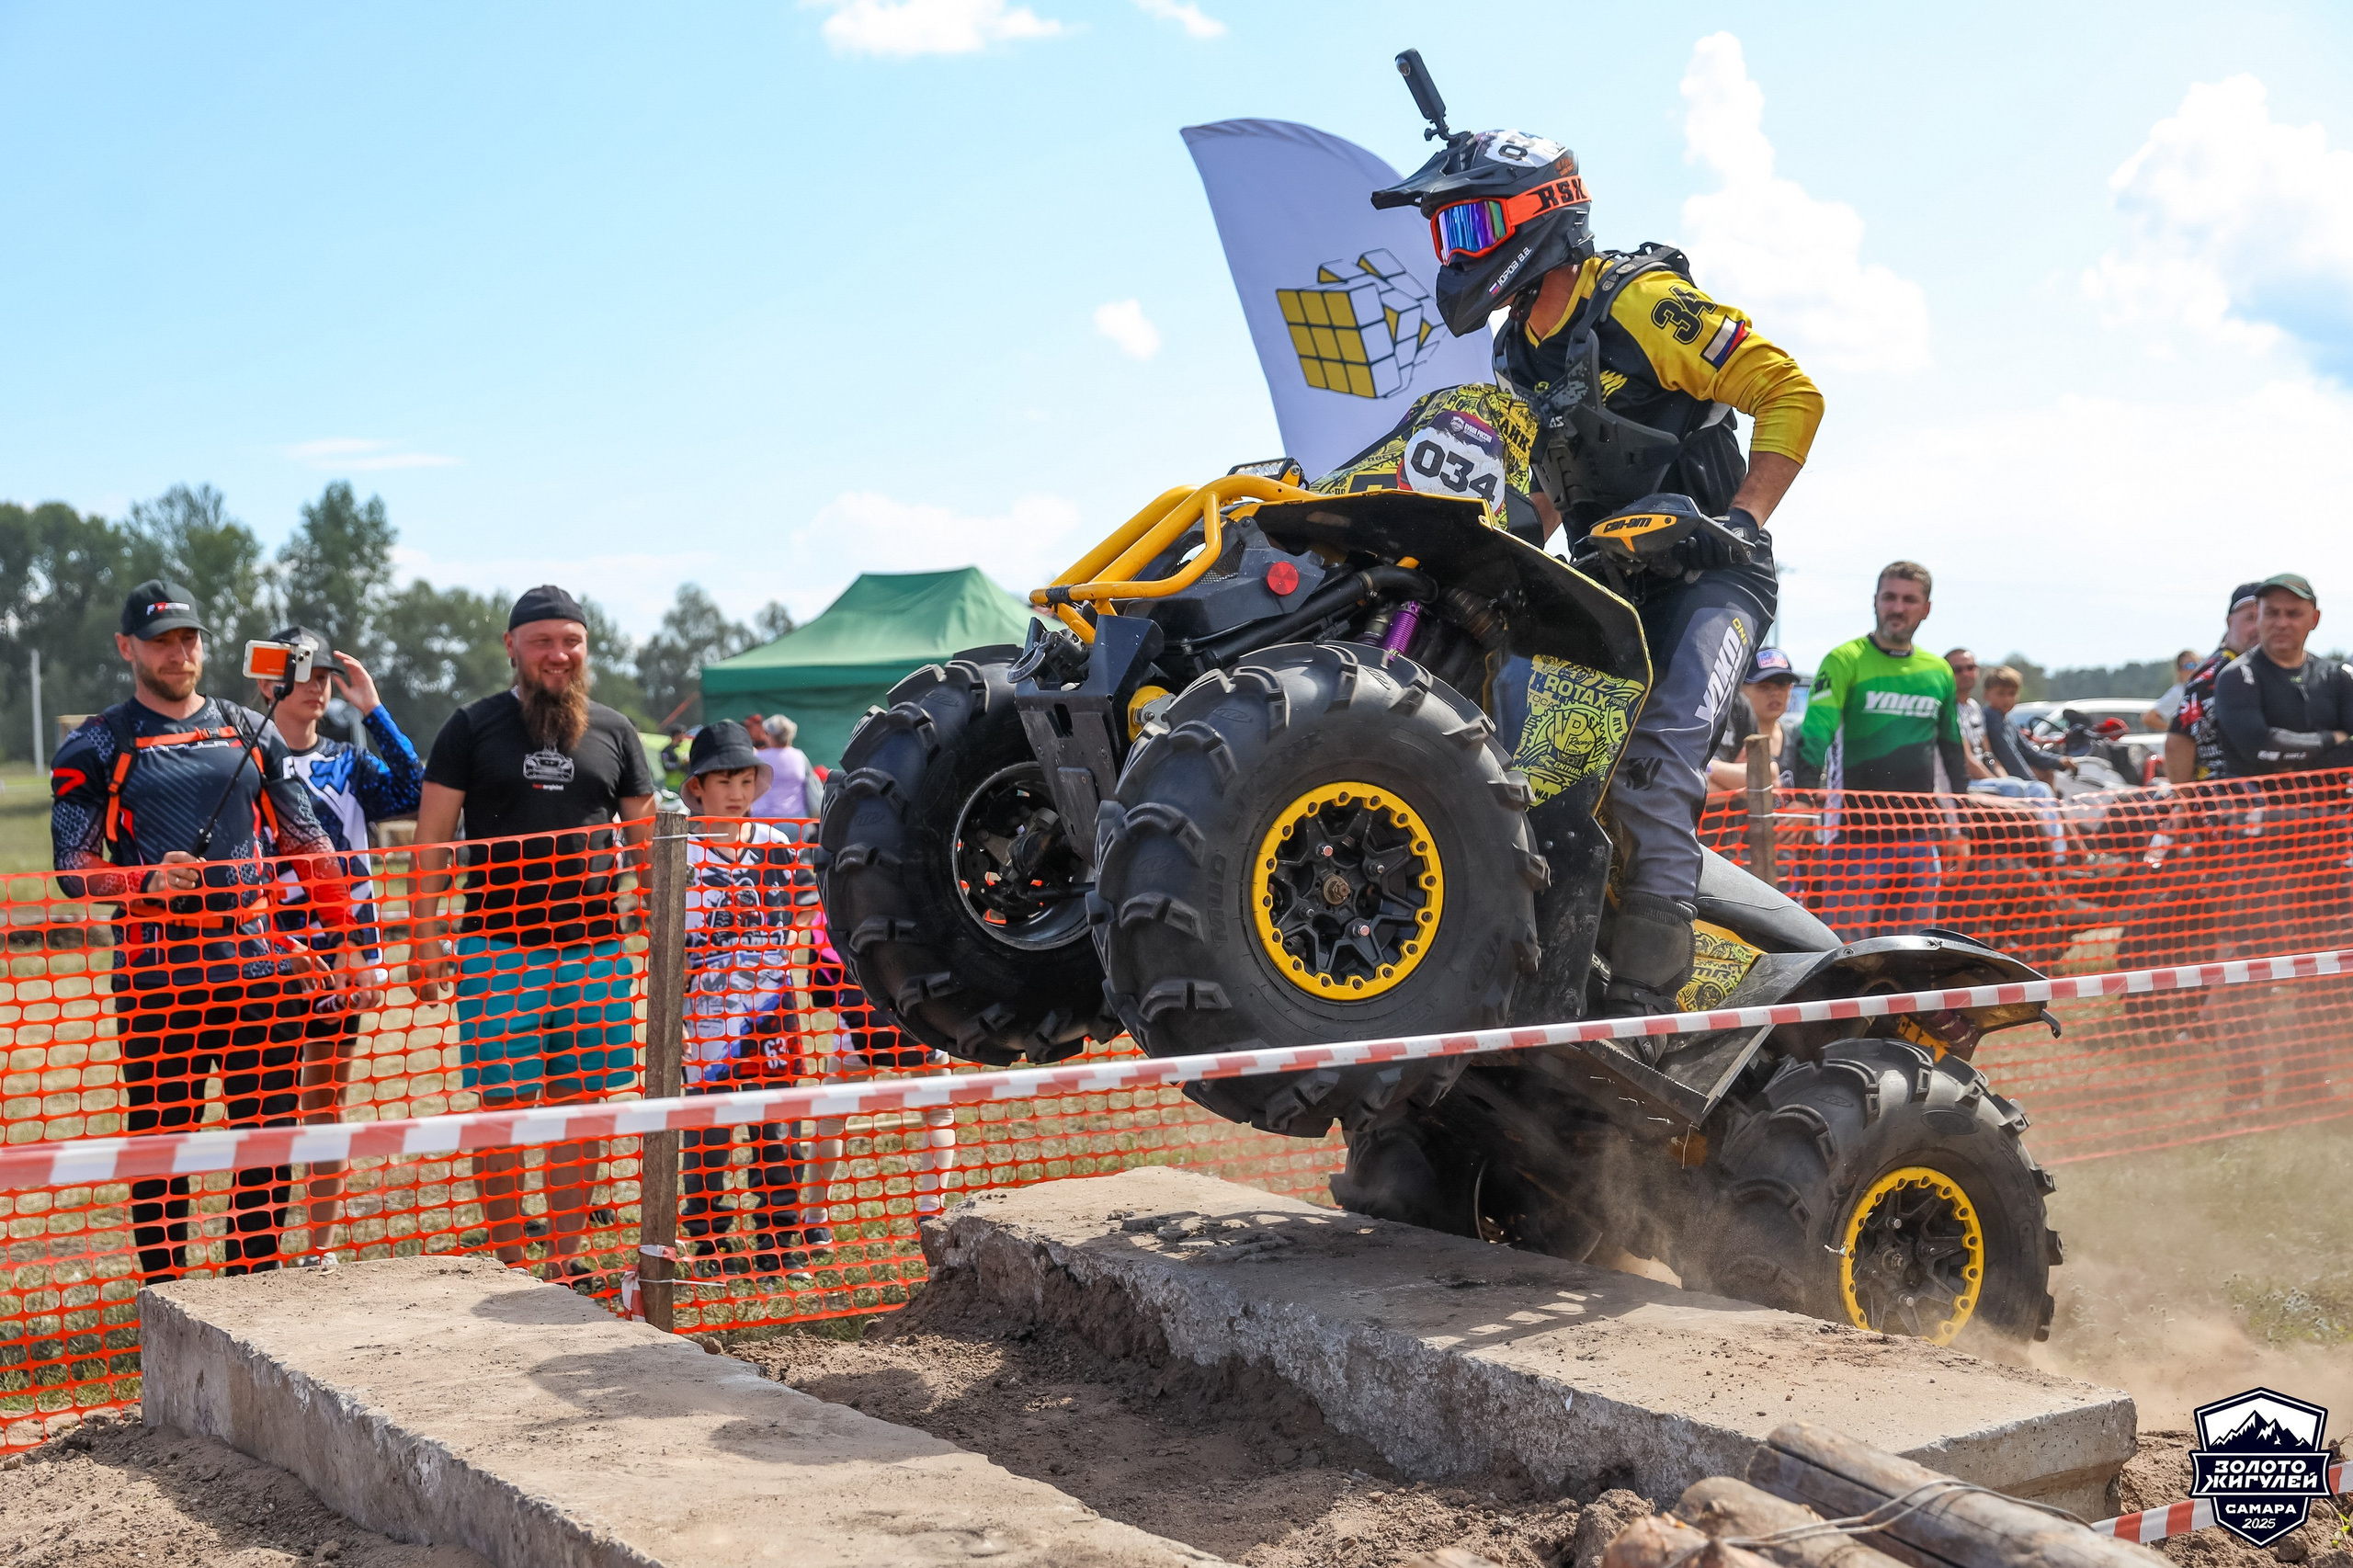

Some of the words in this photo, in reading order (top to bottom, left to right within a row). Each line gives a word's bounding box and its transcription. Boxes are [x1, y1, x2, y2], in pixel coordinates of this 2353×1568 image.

[1497, 260, 1519, 286] ЮРОВ
[1652, 285, 1717, 345] 34
[1498, 418, 1530, 453] АЙК
[1410, 439, 1498, 506] 034
[1603, 517, 1652, 533] can-am
[1695, 626, 1743, 722] YOKO
[1543, 674, 1610, 710] ROTAX
[1609, 697, 1628, 708] POWER
[1864, 690, 1937, 715] YOKO
[1554, 710, 1588, 754] VP
[1566, 736, 1597, 749] Racing
[1208, 854, 1229, 943] MUD
[764, 1038, 788, 1069] 63
